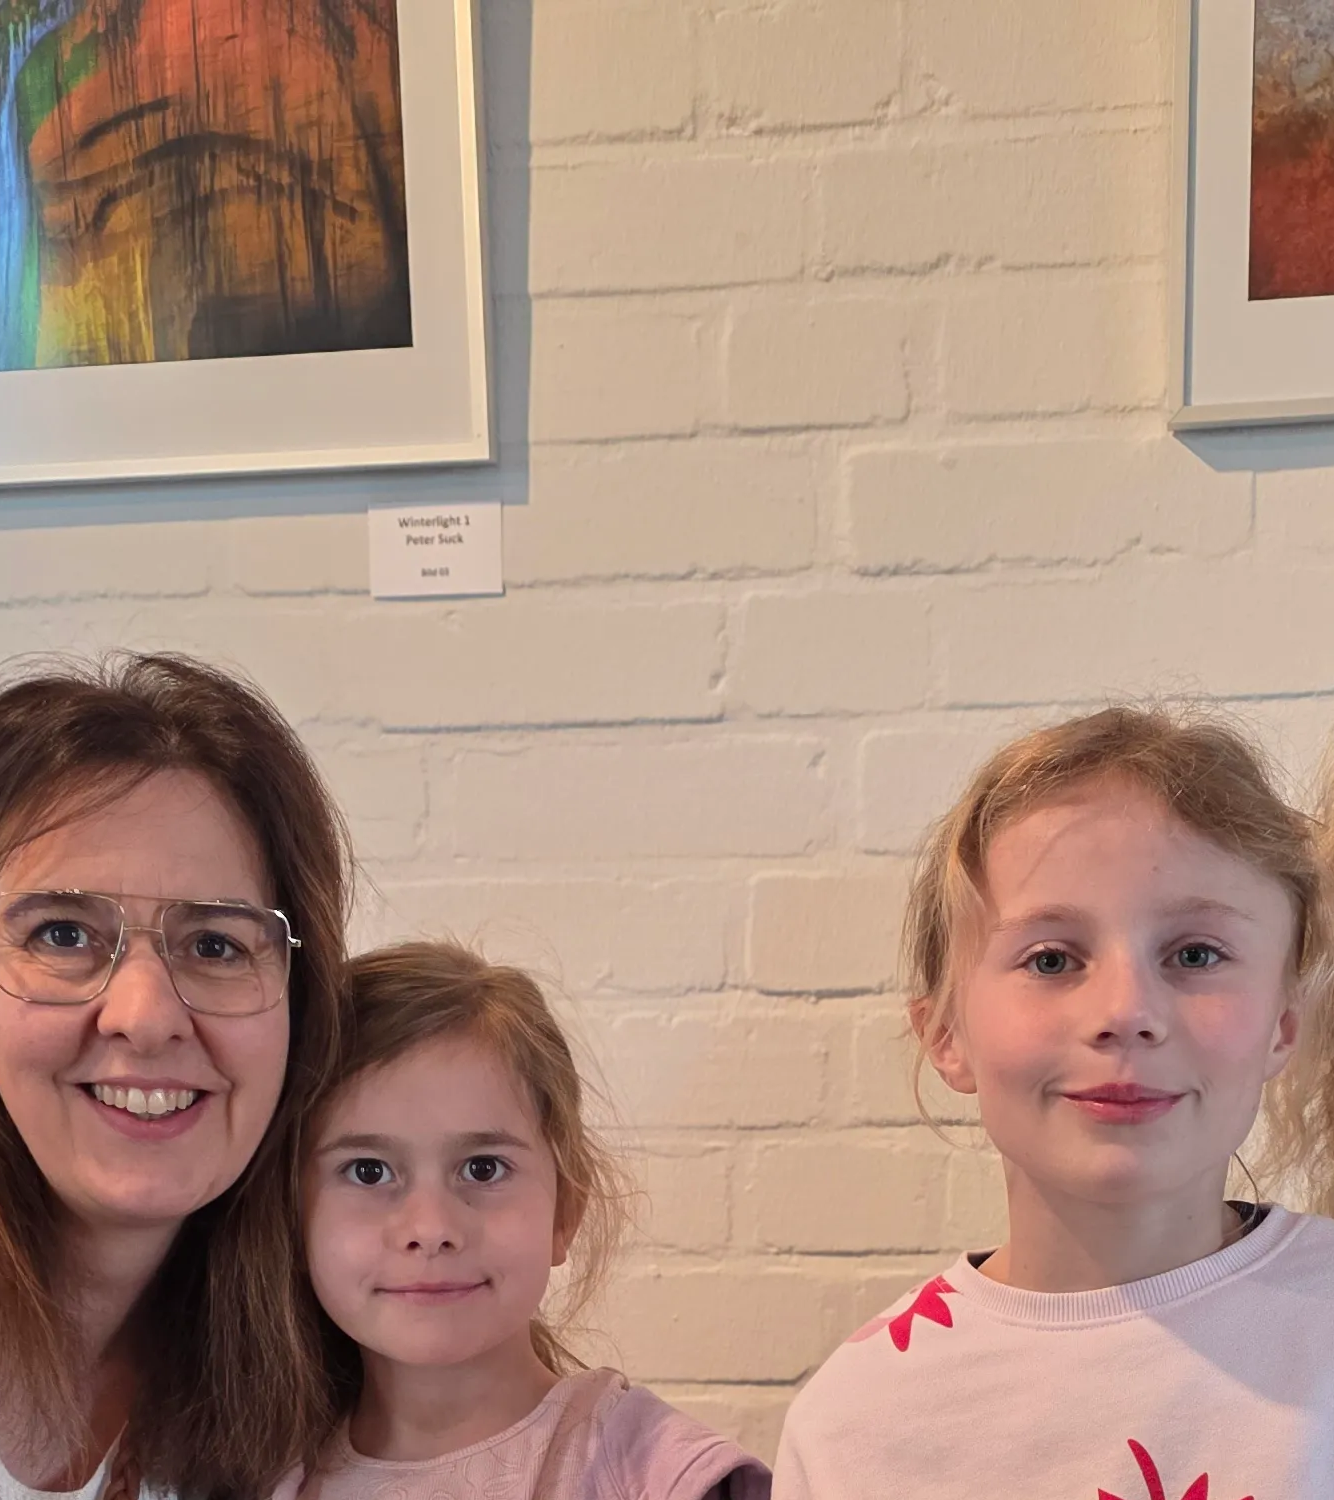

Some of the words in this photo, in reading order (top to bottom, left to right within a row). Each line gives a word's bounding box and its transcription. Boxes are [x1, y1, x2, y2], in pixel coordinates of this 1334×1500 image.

[398, 516, 461, 529] Winterlight
[464, 515, 471, 526] 1
[405, 534, 435, 546] Peter
[438, 533, 464, 544] Suck
